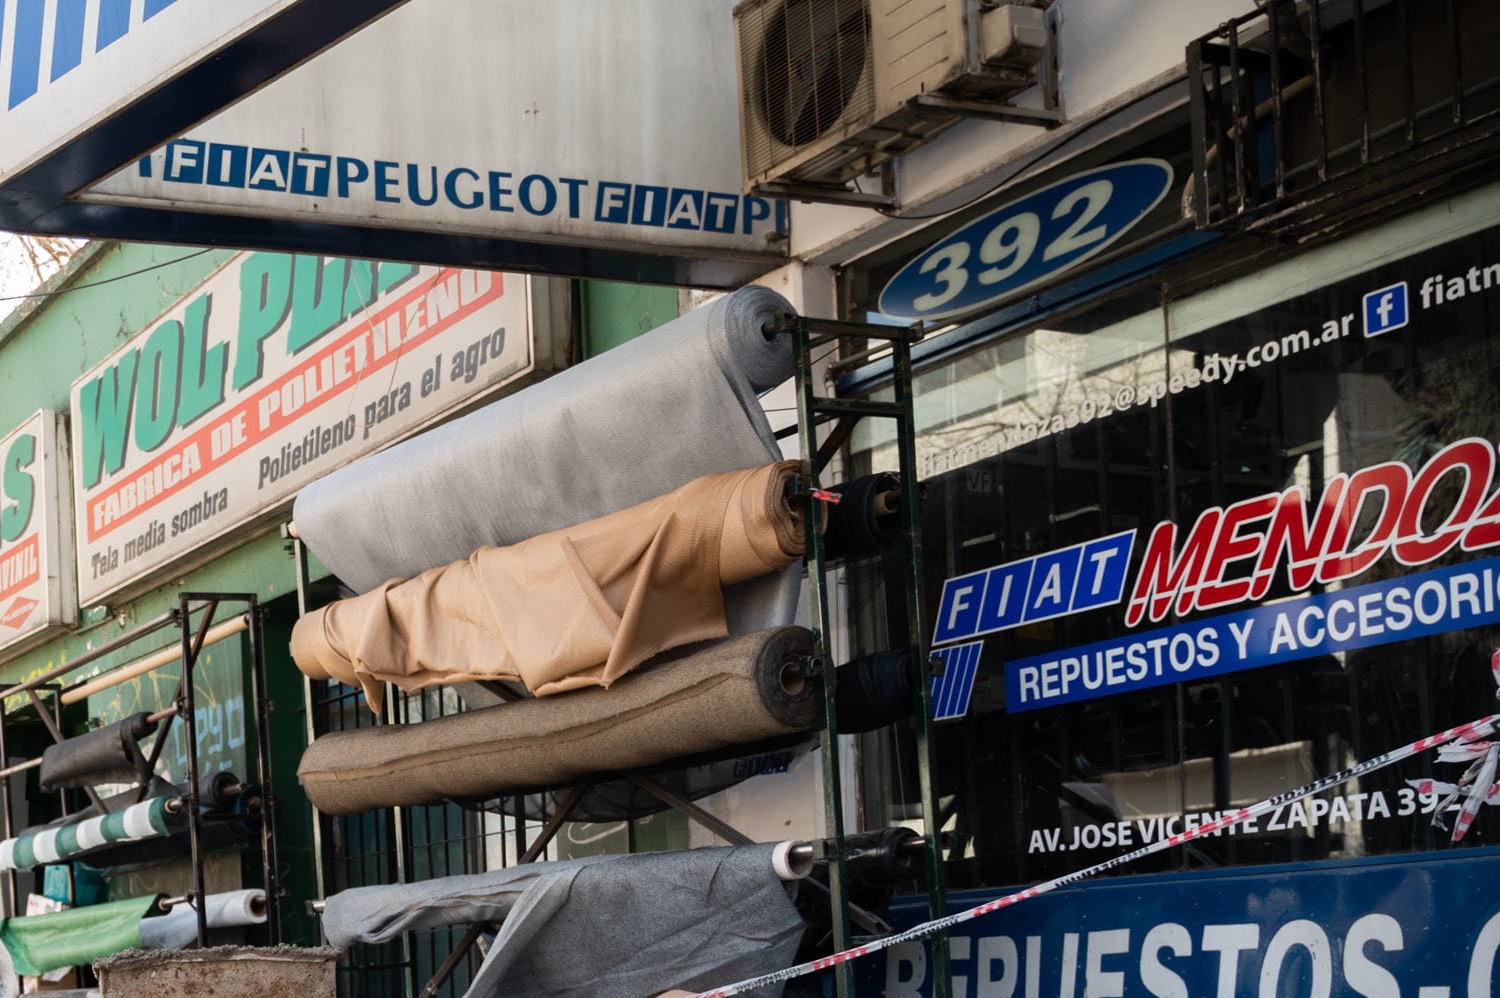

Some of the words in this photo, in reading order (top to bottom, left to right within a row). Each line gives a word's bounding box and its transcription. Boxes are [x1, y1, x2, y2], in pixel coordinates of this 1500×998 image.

[168, 142, 329, 194] FIAT
[336, 156, 588, 218] PEUGEOT
[598, 184, 737, 231] FIAT
[912, 179, 1114, 312] 392
[80, 292, 229, 490] WOL
[91, 549, 119, 580] Tela
[124, 520, 166, 564] media
[171, 487, 228, 538] sombra
[258, 414, 356, 489] Polietileno
[363, 381, 412, 440] para
[421, 354, 443, 398] el
[450, 327, 506, 384] agro
[94, 442, 202, 532] FABRICA
[211, 411, 248, 458] DE
[258, 270, 493, 432] POLIETILENO
[940, 538, 1128, 637] FIAT
[1019, 628, 1221, 703] REPUESTOS
[1229, 622, 1254, 660] Y
[1271, 568, 1500, 654] ACCESORI
[1069, 821, 1132, 851] JOSE
[1267, 791, 1391, 832] ZAPATA
[1397, 788, 1461, 816] 39
